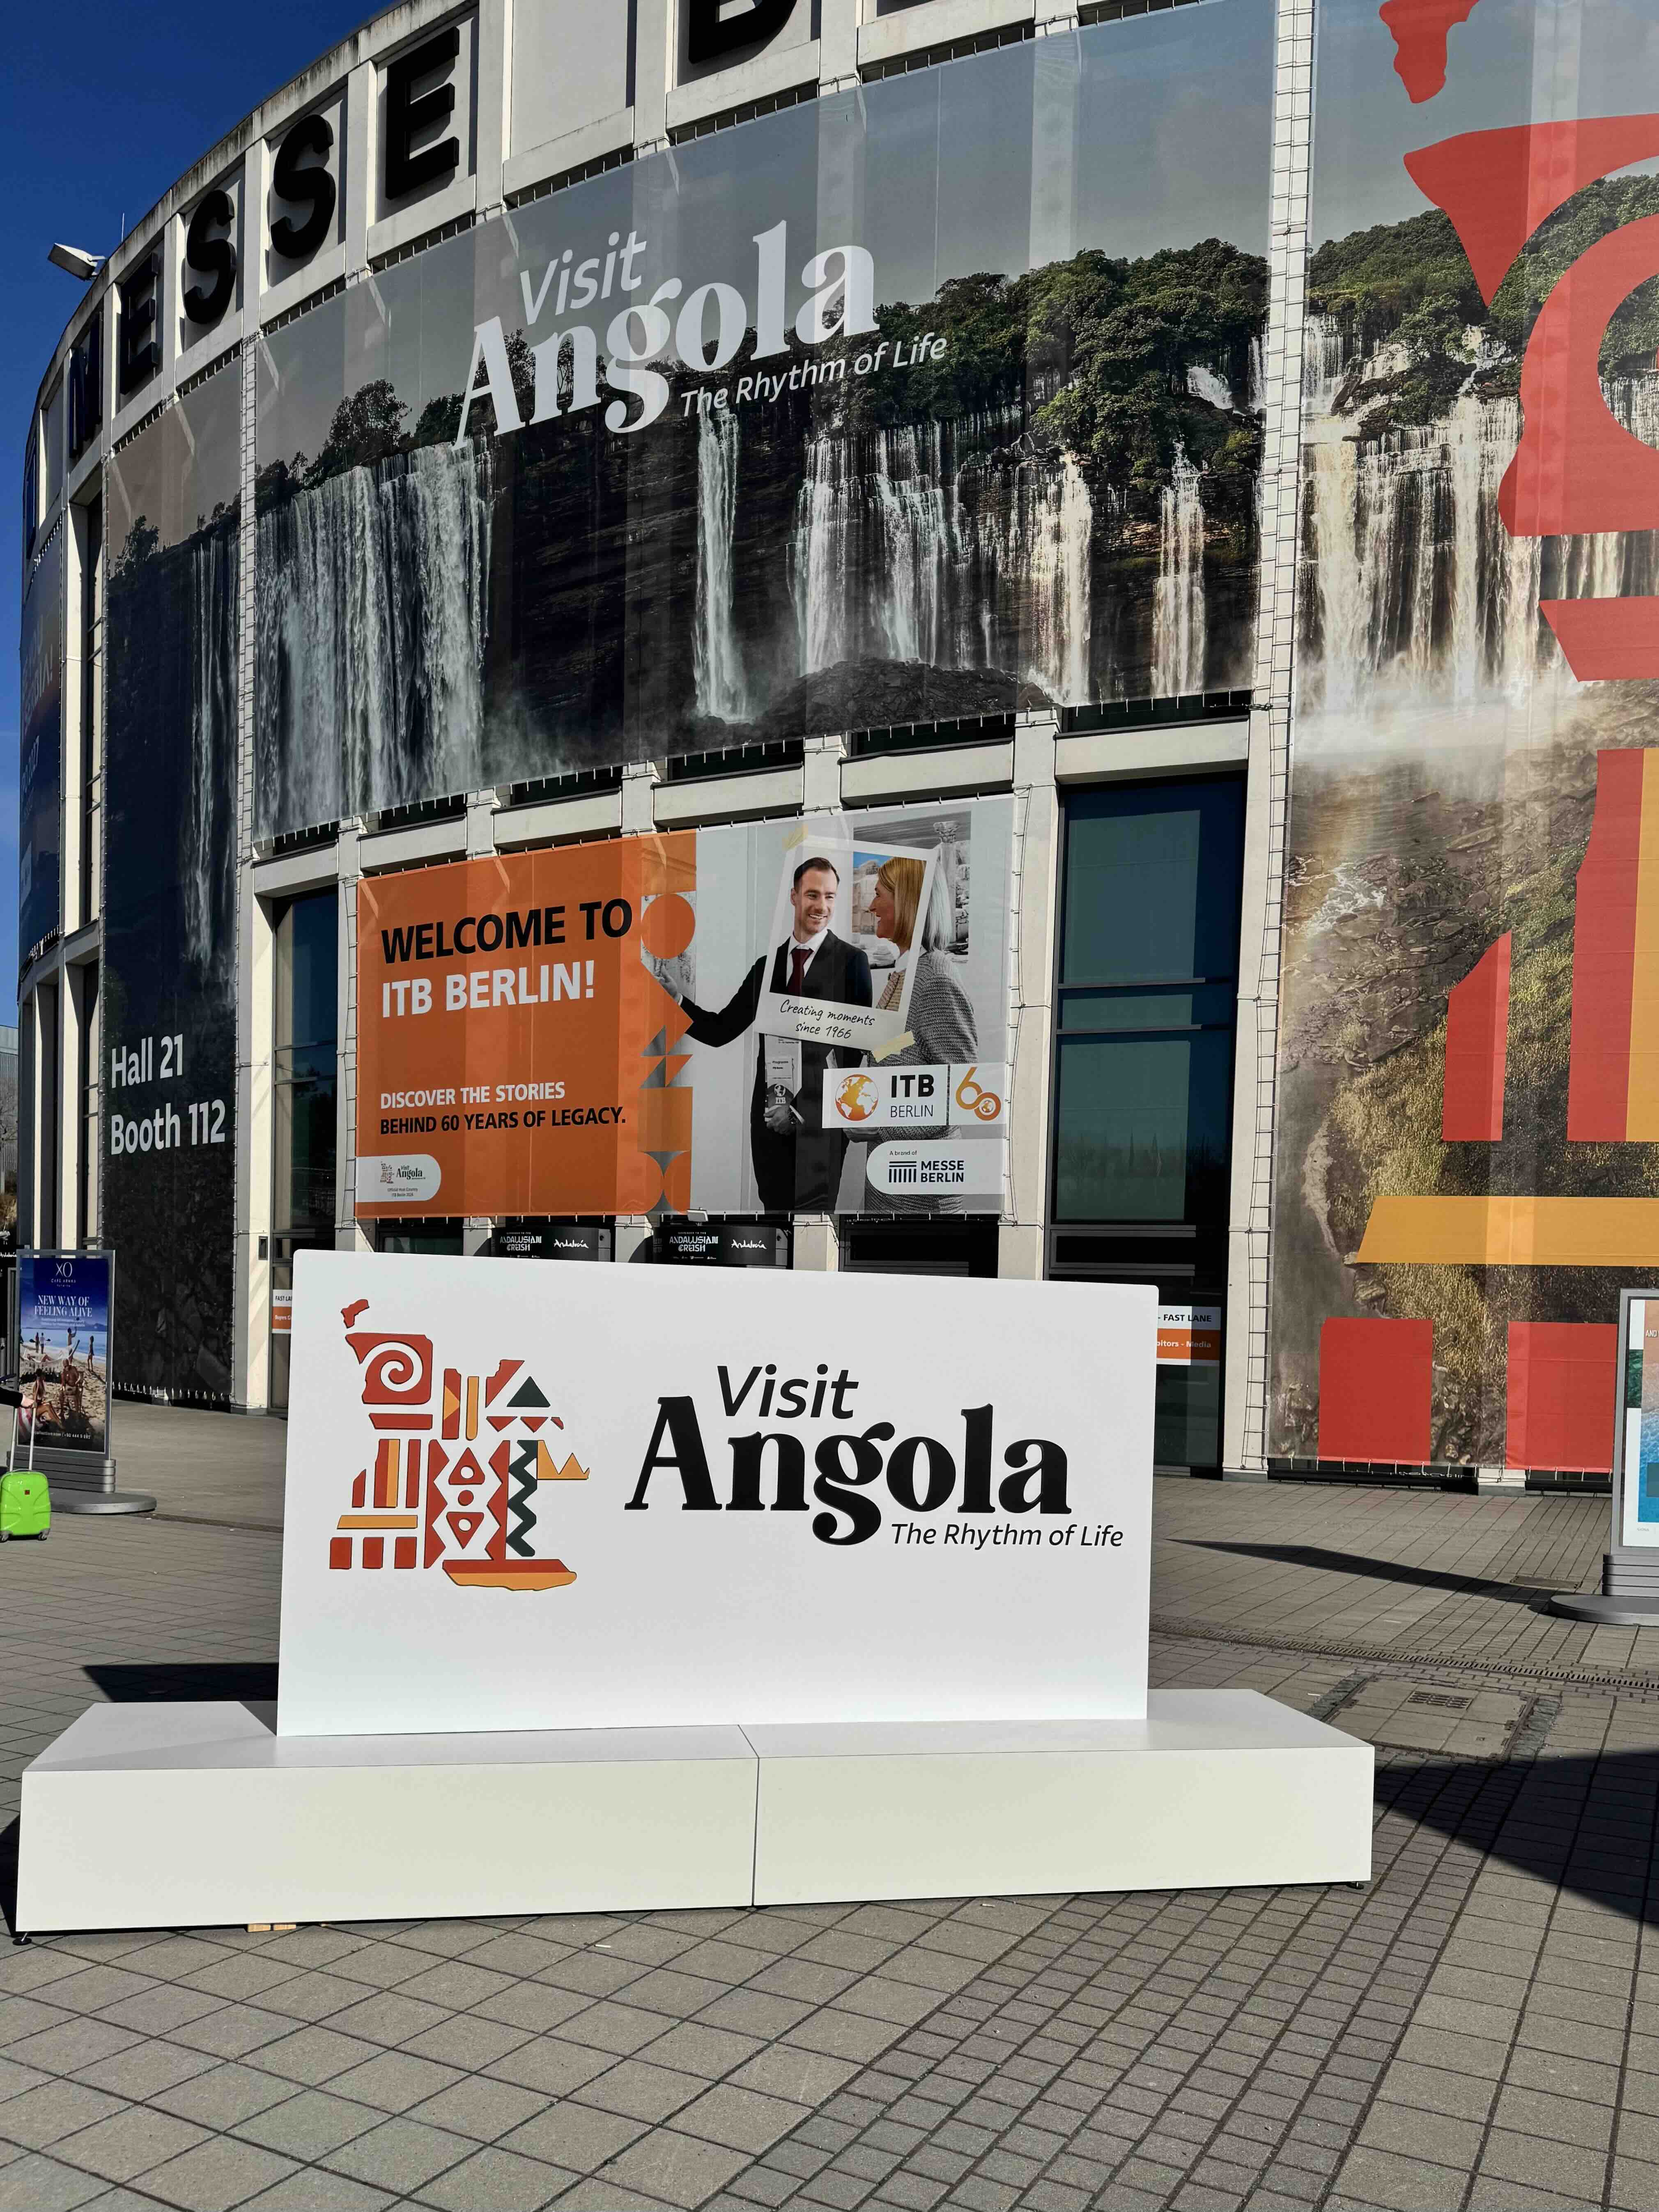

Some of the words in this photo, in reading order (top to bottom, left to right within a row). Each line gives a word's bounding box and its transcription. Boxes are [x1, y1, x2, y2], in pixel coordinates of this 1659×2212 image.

[520, 230, 647, 325] Visit
[451, 220, 880, 451] Angola
[681, 387, 728, 417] The
[736, 358, 845, 403] Rhythm
[855, 342, 898, 375] of
[893, 332, 947, 368] Life
[381, 905, 565, 964] WELCOME
[579, 898, 632, 940] TO
[382, 978, 432, 1018] ITB
[446, 960, 595, 1011] BERLIN!
[780, 999, 823, 1021] Creating
[827, 1011, 875, 1026] moments
[795, 1022, 821, 1035] since
[825, 1026, 852, 1039] 1966
[112, 1036, 152, 1088] Hall
[160, 1034, 183, 1079] 21
[380, 1089, 455, 1109] DISCOVER
[460, 1086, 490, 1104] THE
[496, 1082, 565, 1103] STORIES
[890, 1074, 935, 1098] ITB
[380, 1116, 437, 1135] BEHIND
[441, 1114, 460, 1131] 60
[464, 1111, 519, 1130] YEARS
[523, 1110, 546, 1128] OF
[551, 1106, 626, 1127] LEGACY.
[890, 1104, 934, 1118] BERLIN
[111, 1103, 181, 1155] Booth
[188, 1099, 225, 1146] 112
[396, 1167, 423, 1180] Angola
[920, 1172, 965, 1183] BERLIN
[921, 1160, 965, 1171] MESSE
[499, 1236, 542, 1244] ANDALUSIAN
[669, 1236, 719, 1244] ANDALUSIAN
[56, 1262, 73, 1277] XO
[34, 1305, 67, 1316] FEELING
[69, 1307, 92, 1317] ALIVE
[38, 1295, 56, 1305] NEW
[57, 1296, 76, 1306] WAY
[78, 1296, 90, 1307] OF
[717, 1363, 859, 1420] Visit
[624, 1395, 1072, 1546] Angola
[891, 1523, 937, 1546] The
[943, 1523, 1042, 1550] Rhythm
[1048, 1524, 1079, 1546] of
[1080, 1524, 1124, 1547] Life
